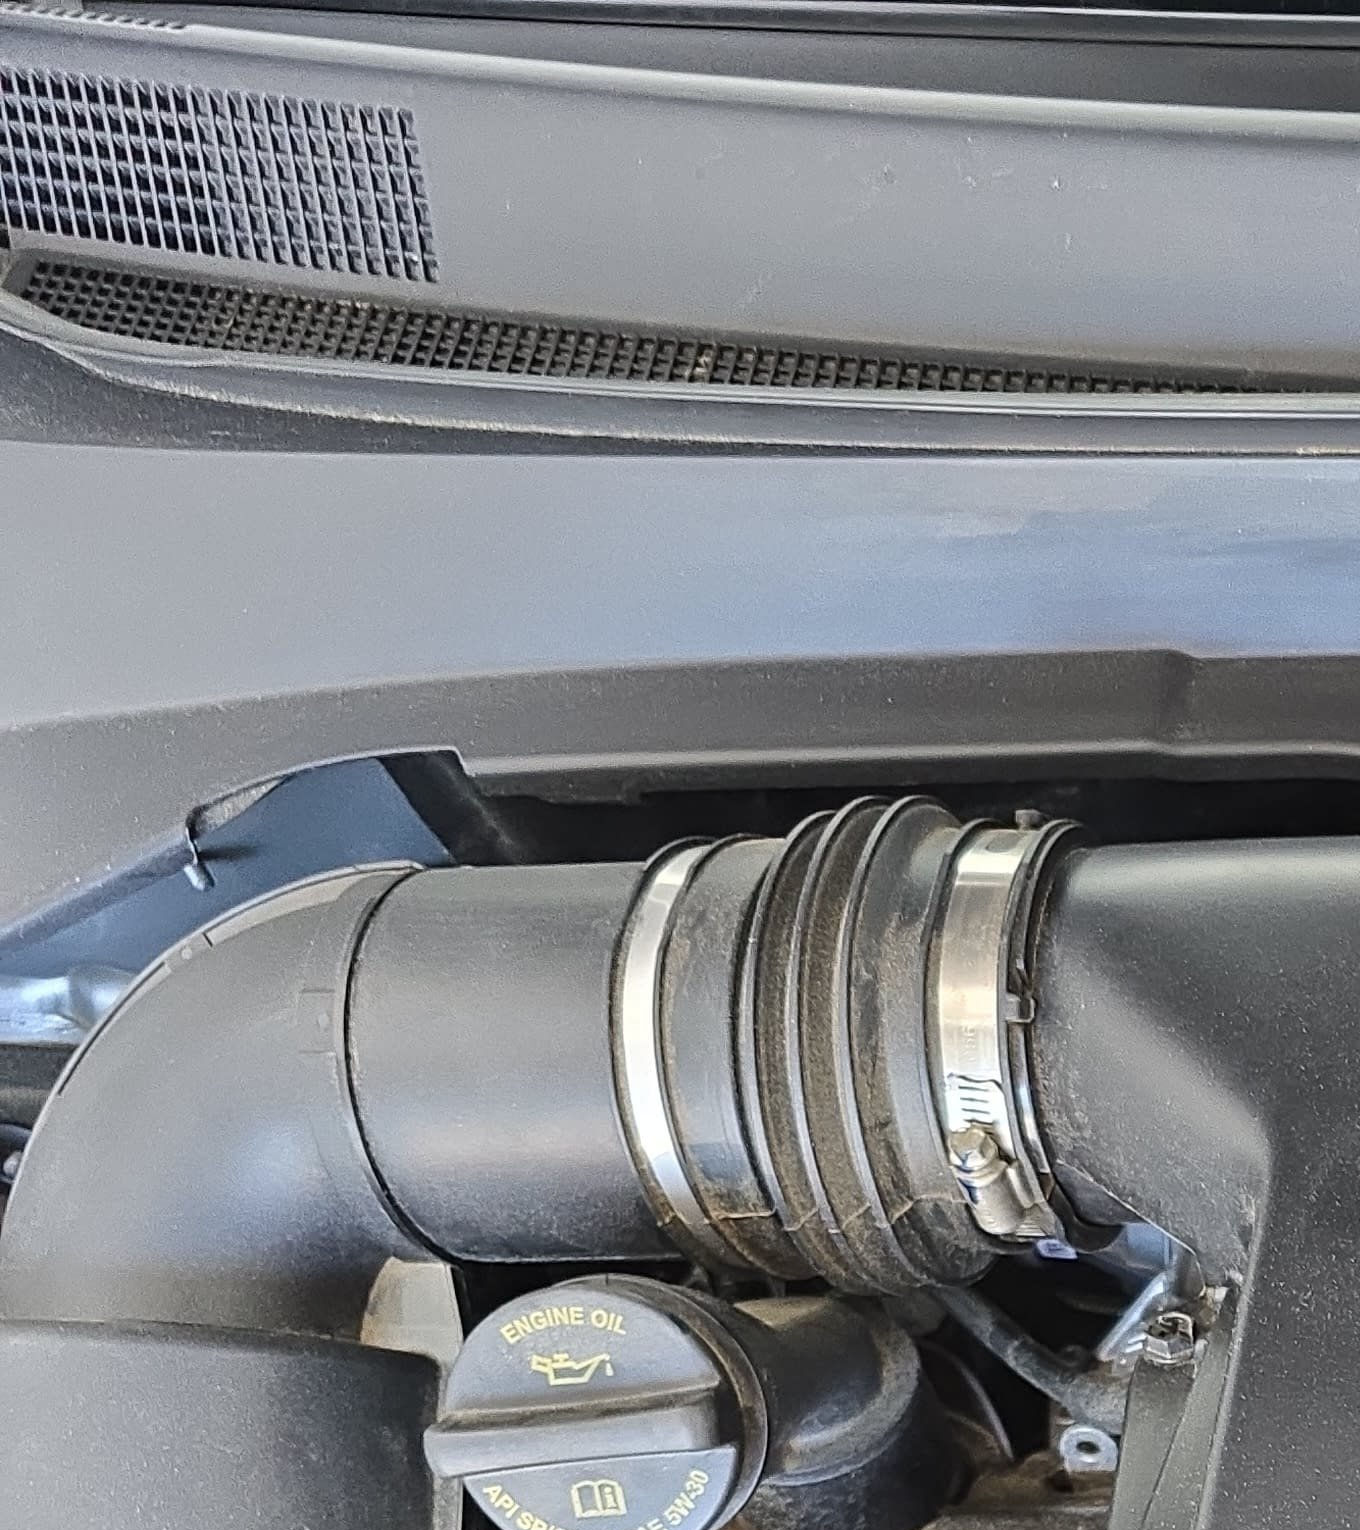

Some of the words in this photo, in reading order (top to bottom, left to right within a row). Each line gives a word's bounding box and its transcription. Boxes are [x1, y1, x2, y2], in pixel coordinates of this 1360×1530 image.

[500, 1306, 584, 1345] ENGINE
[590, 1309, 627, 1336] OIL
[482, 1484, 520, 1520] API
[665, 1469, 711, 1527] 5W-30
